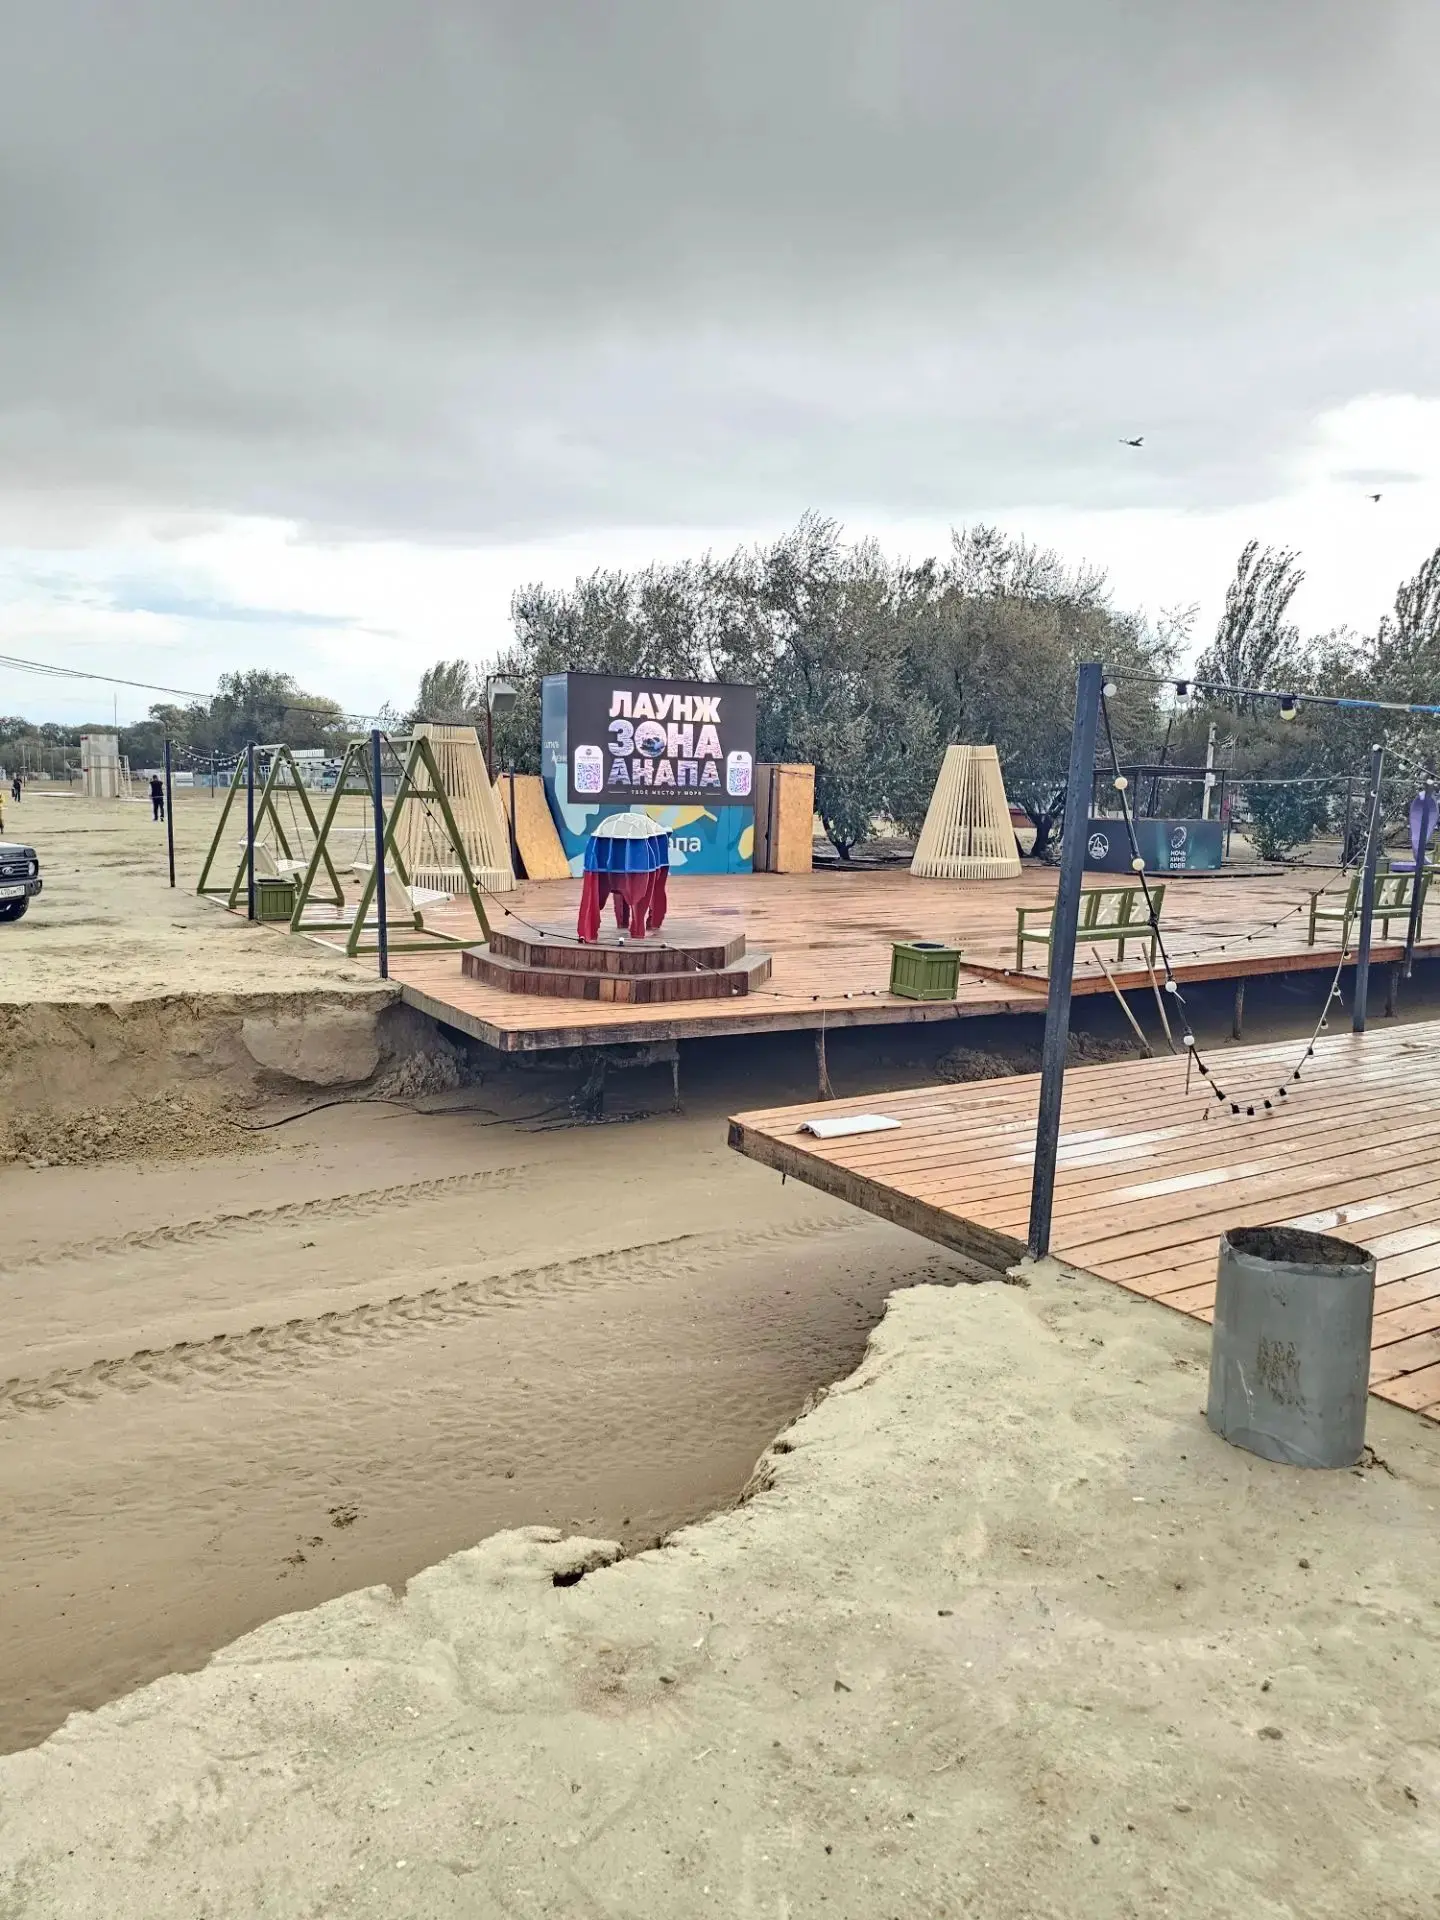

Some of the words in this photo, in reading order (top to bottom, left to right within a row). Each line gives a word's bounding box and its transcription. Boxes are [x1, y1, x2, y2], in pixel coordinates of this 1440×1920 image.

[609, 690, 722, 723] ЛАУНЖ
[607, 719, 724, 759] ЗОНА
[607, 757, 722, 788] АНАПА
